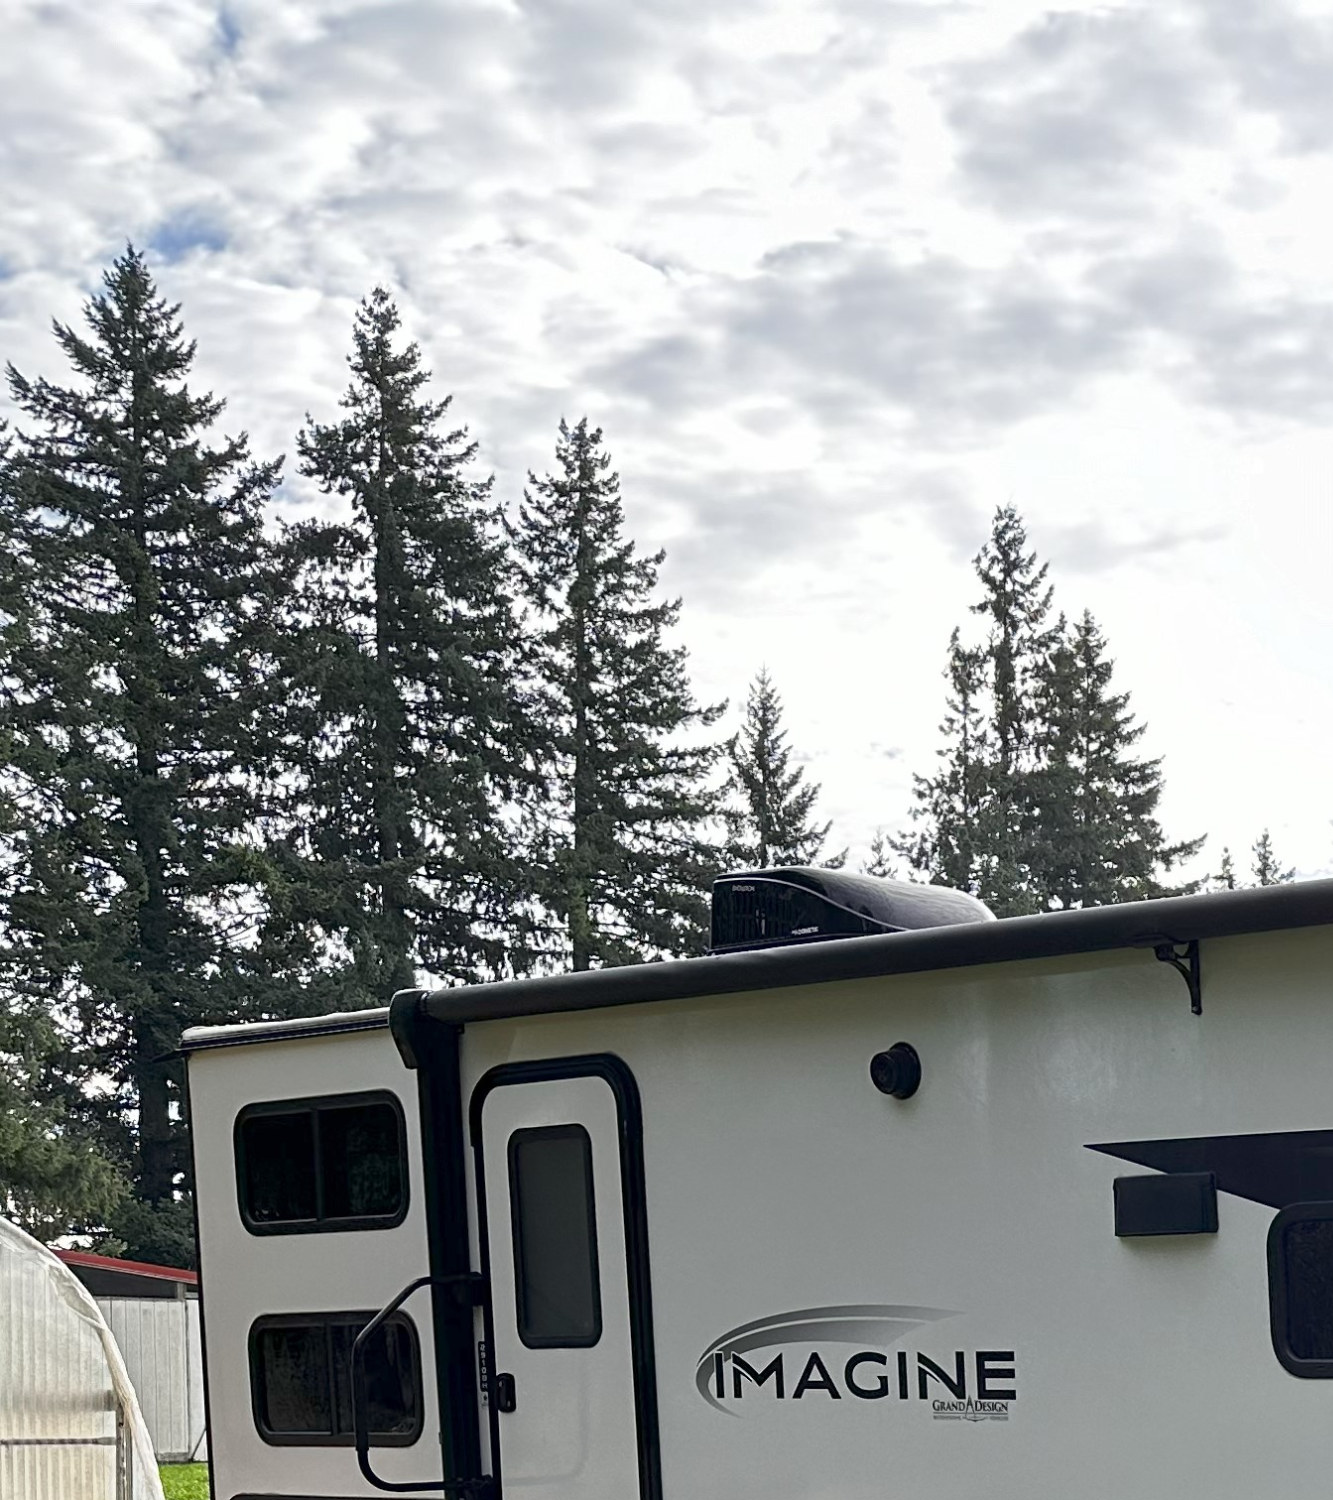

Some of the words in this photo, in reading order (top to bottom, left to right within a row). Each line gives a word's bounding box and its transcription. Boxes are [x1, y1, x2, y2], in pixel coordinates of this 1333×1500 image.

[714, 1350, 1017, 1400] IMAGINE
[932, 1399, 965, 1411] GRAND
[975, 1400, 1009, 1412] DESIGN
